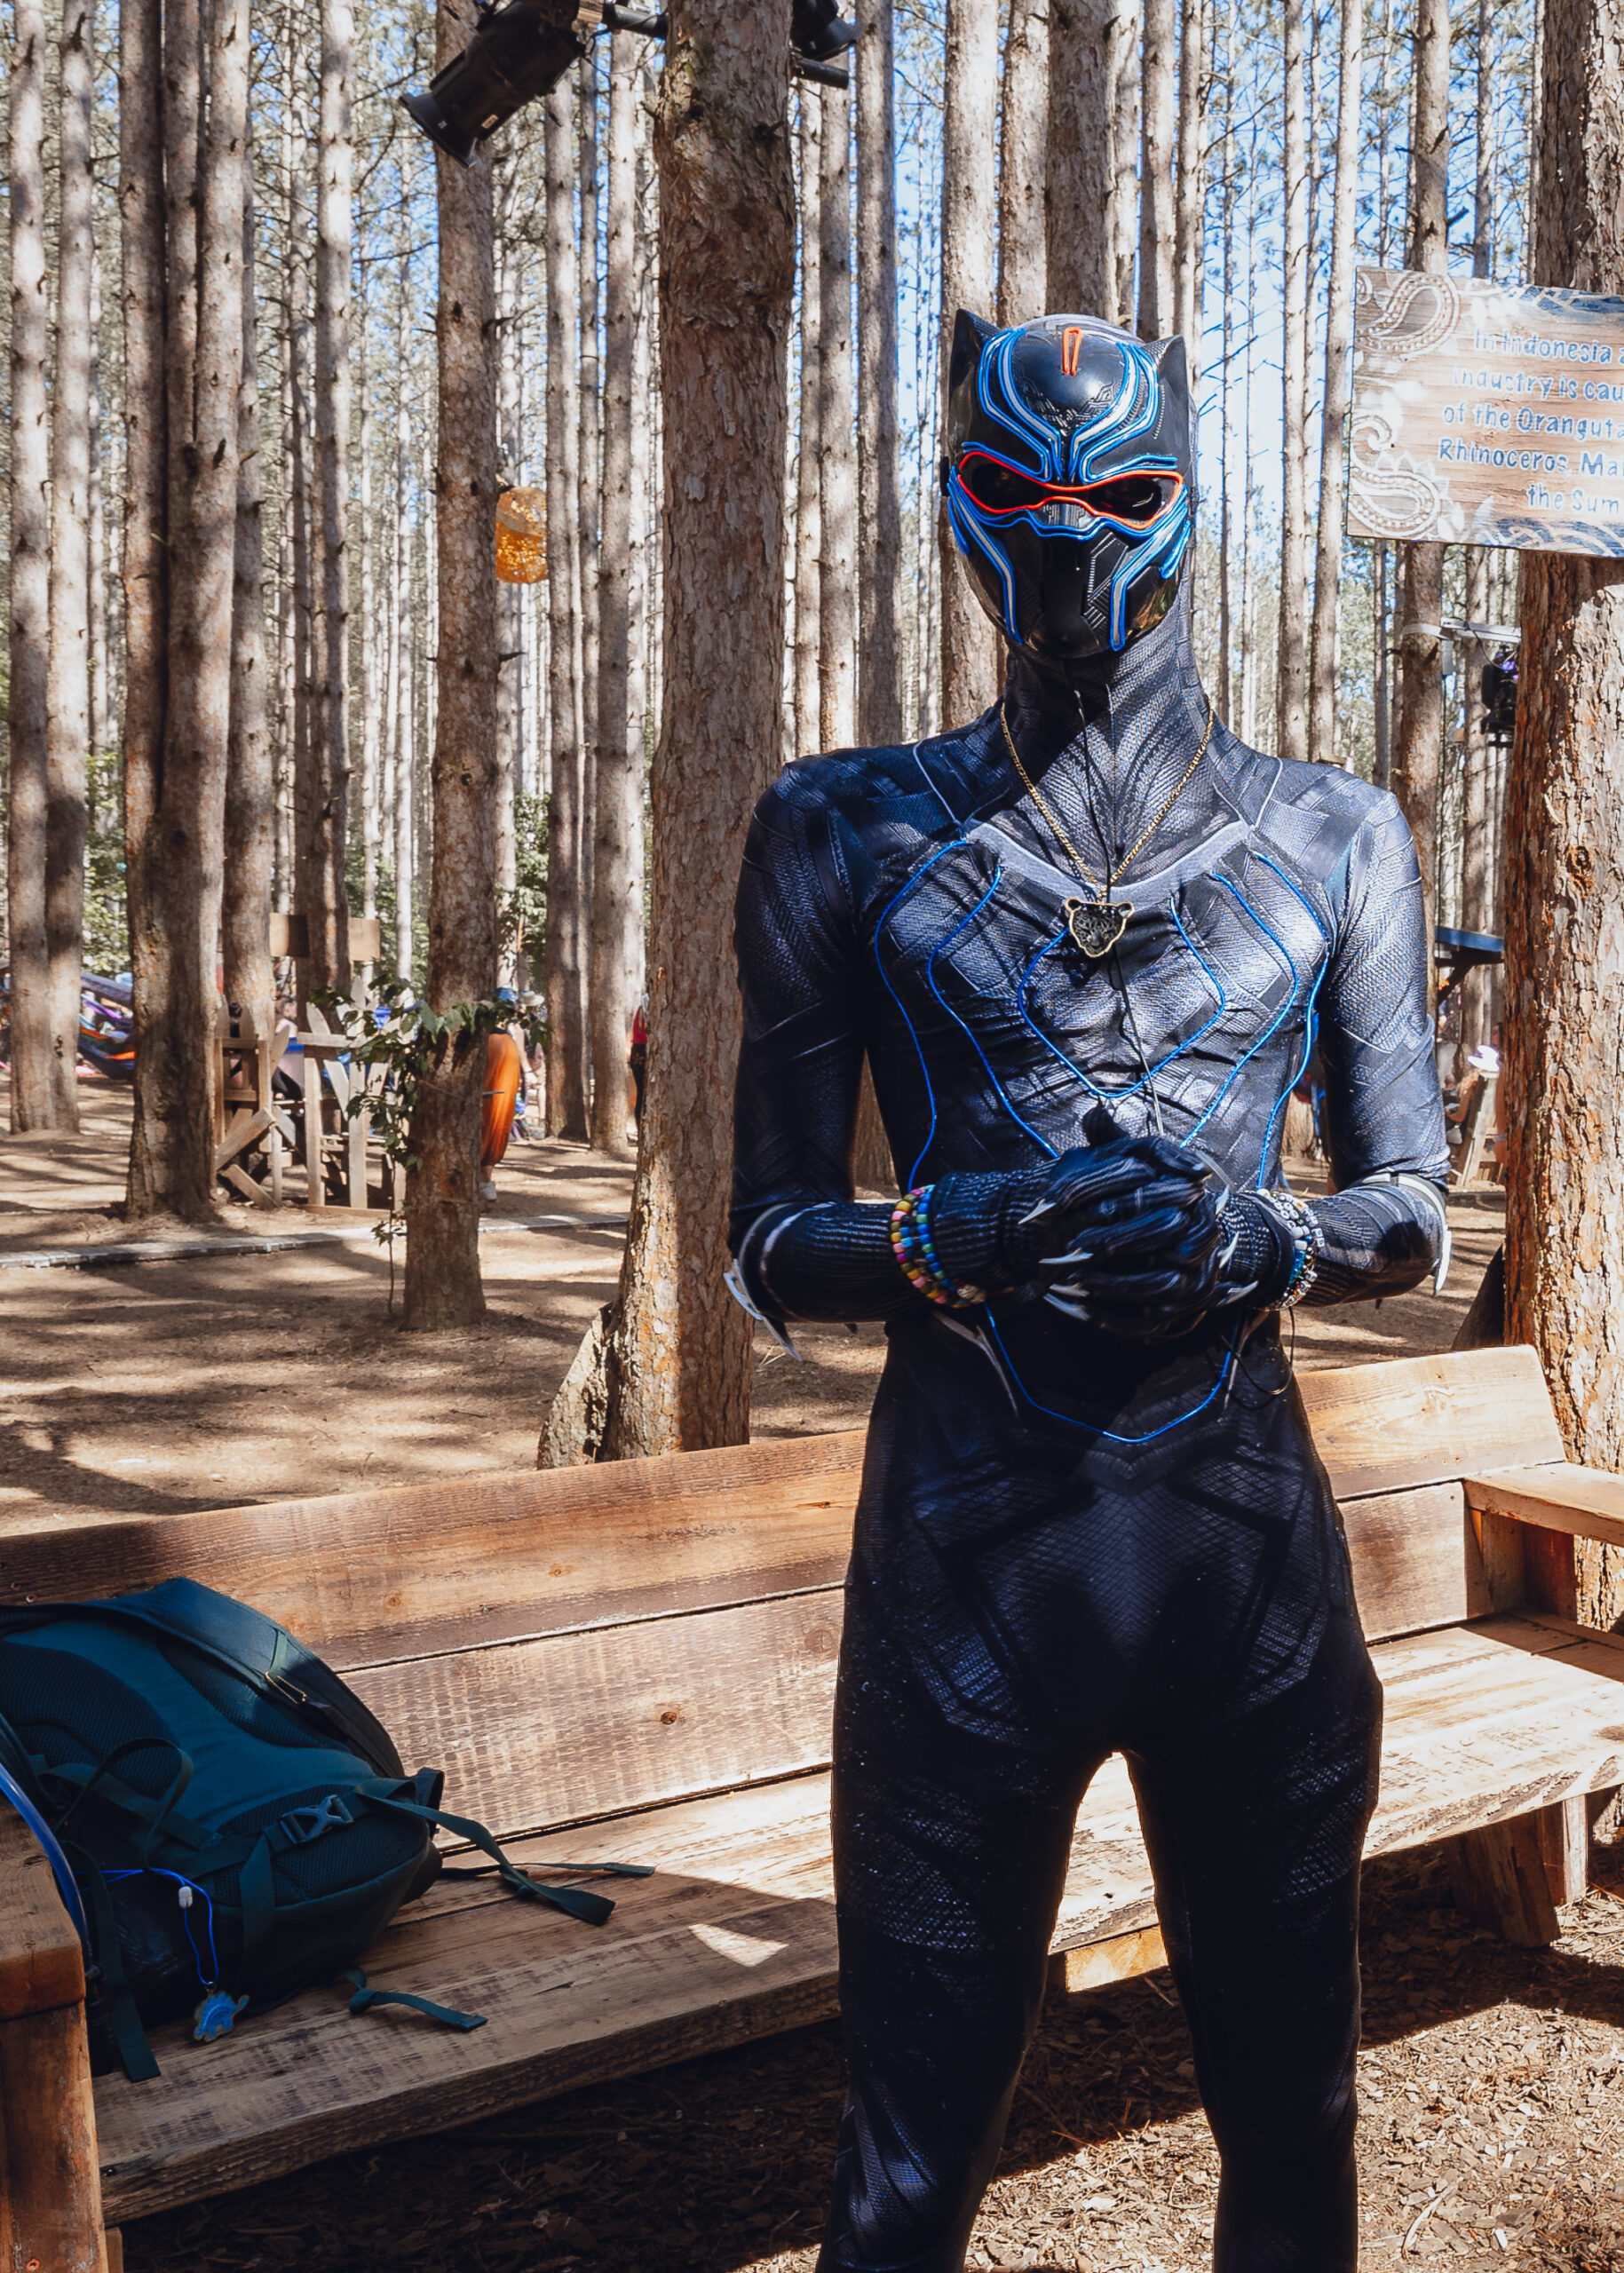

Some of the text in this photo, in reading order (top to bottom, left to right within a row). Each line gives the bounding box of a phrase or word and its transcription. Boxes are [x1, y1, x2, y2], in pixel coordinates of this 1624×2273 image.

[1475, 329, 1494, 351] In
[1502, 330, 1612, 363] Indonesia
[1559, 375, 1578, 399] is
[1584, 382, 1624, 401] cau
[1444, 402, 1465, 424] of
[1475, 404, 1510, 428] the
[1528, 484, 1620, 513] the Sum
